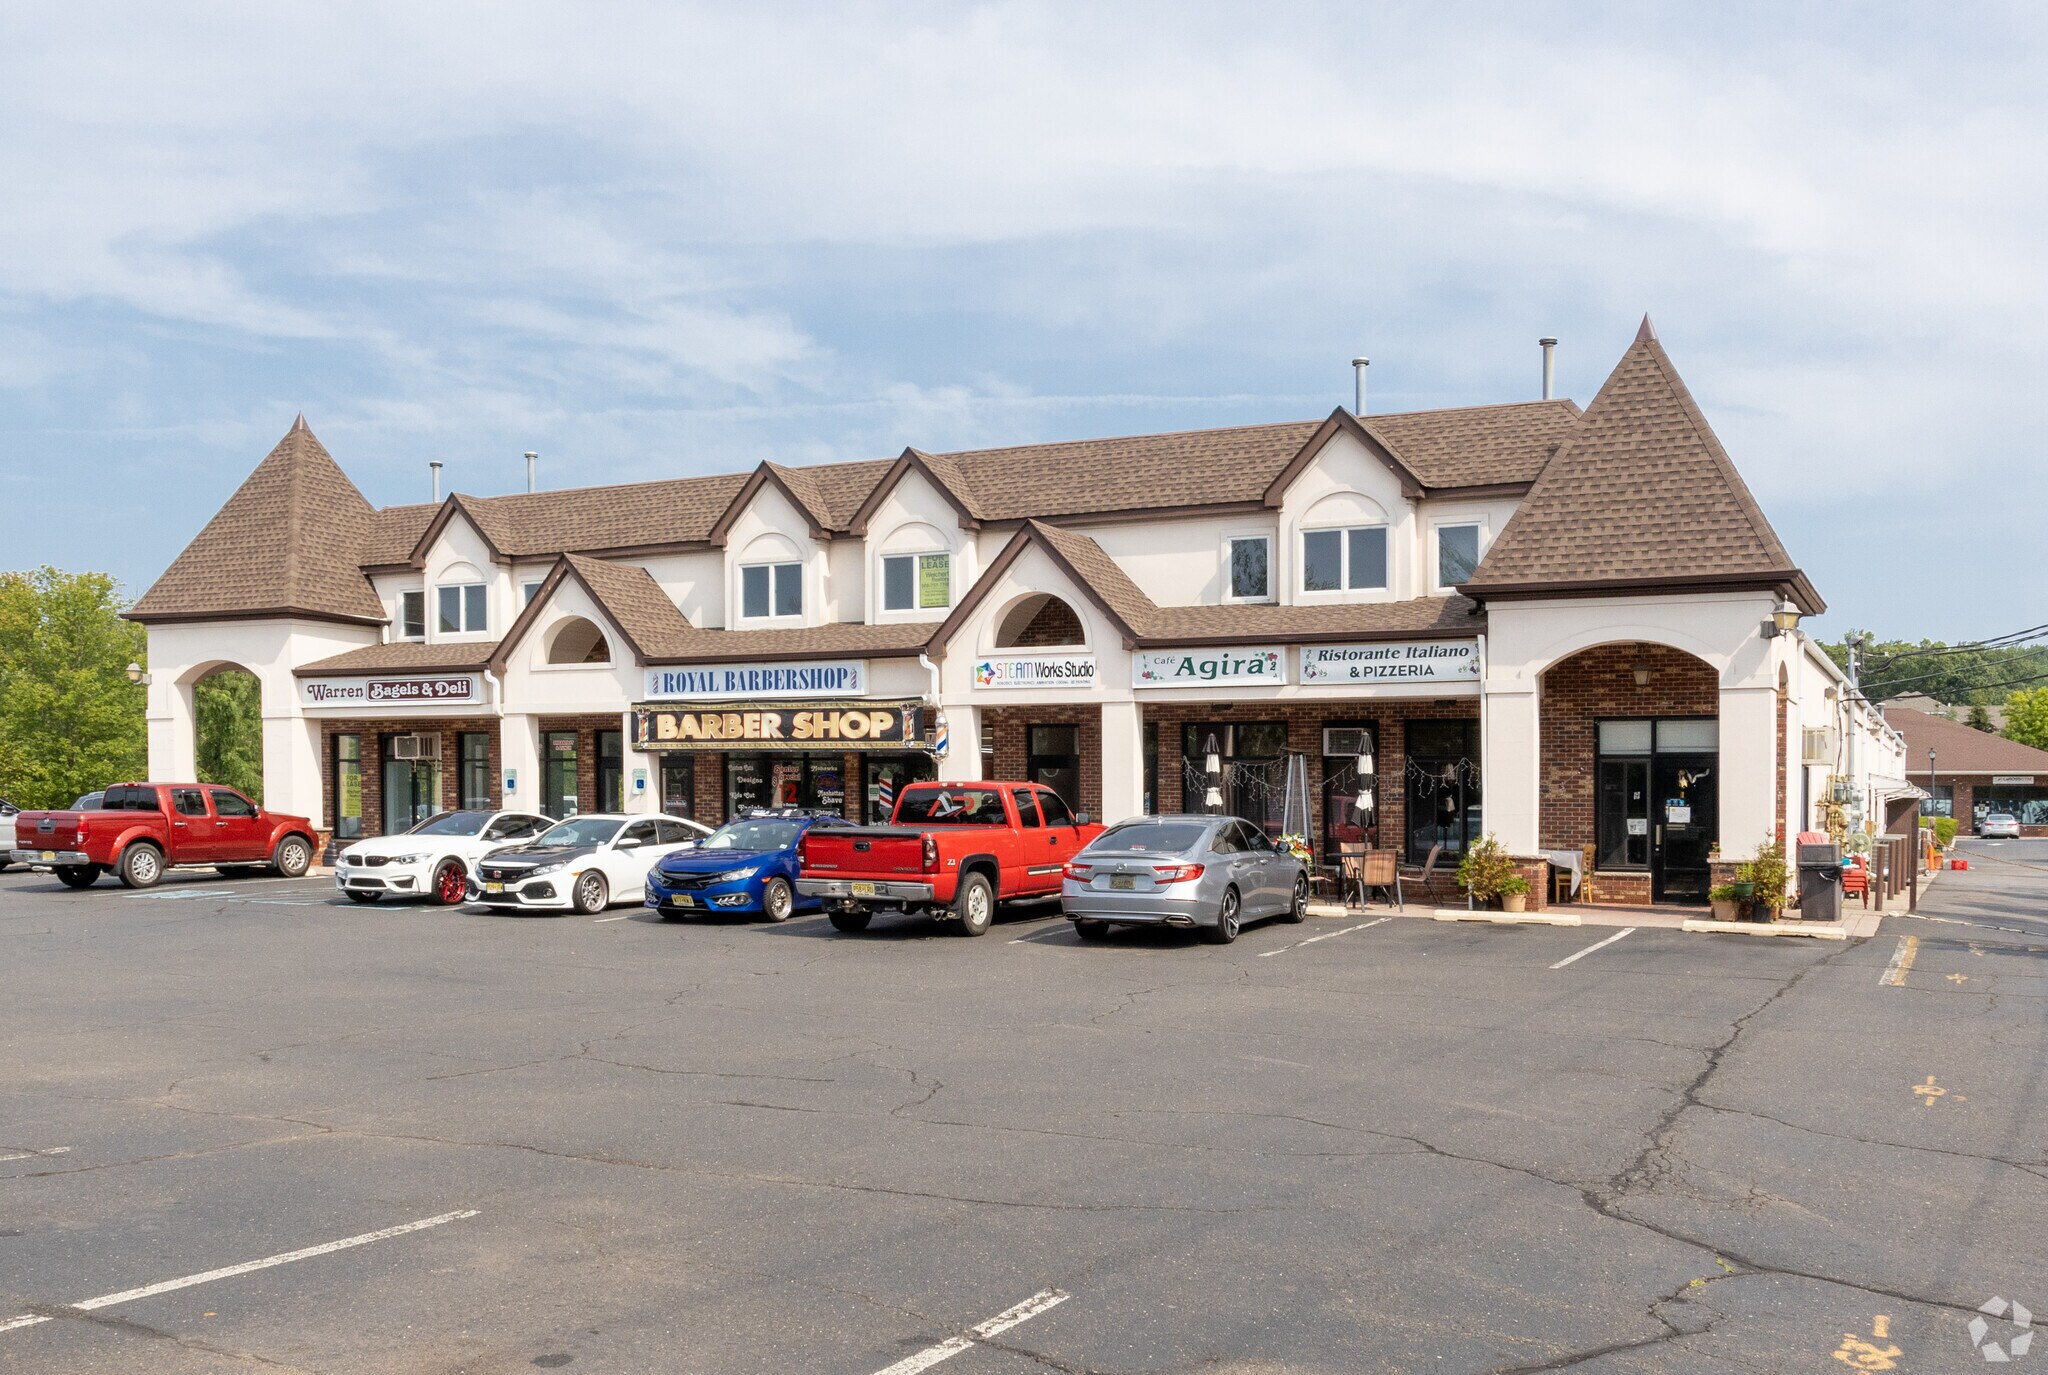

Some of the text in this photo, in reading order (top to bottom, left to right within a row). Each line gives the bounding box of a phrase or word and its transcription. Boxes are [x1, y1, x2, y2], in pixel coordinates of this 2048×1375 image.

[1317, 645, 1470, 662] Ristorante Italiano
[996, 660, 1094, 679] STEAM Works Studio
[1154, 655, 1175, 665] Café
[1174, 653, 1265, 680] Agira
[1349, 664, 1434, 678] & PIZZERIA
[663, 667, 849, 693] ROYAL BARBERSHOP
[307, 681, 468, 701] Warren Bagels & Deli
[656, 710, 894, 740] BARBER SHOP
[774, 765, 800, 774] Senior
[737, 776, 763, 784] Designs
[822, 797, 843, 805] Shave
